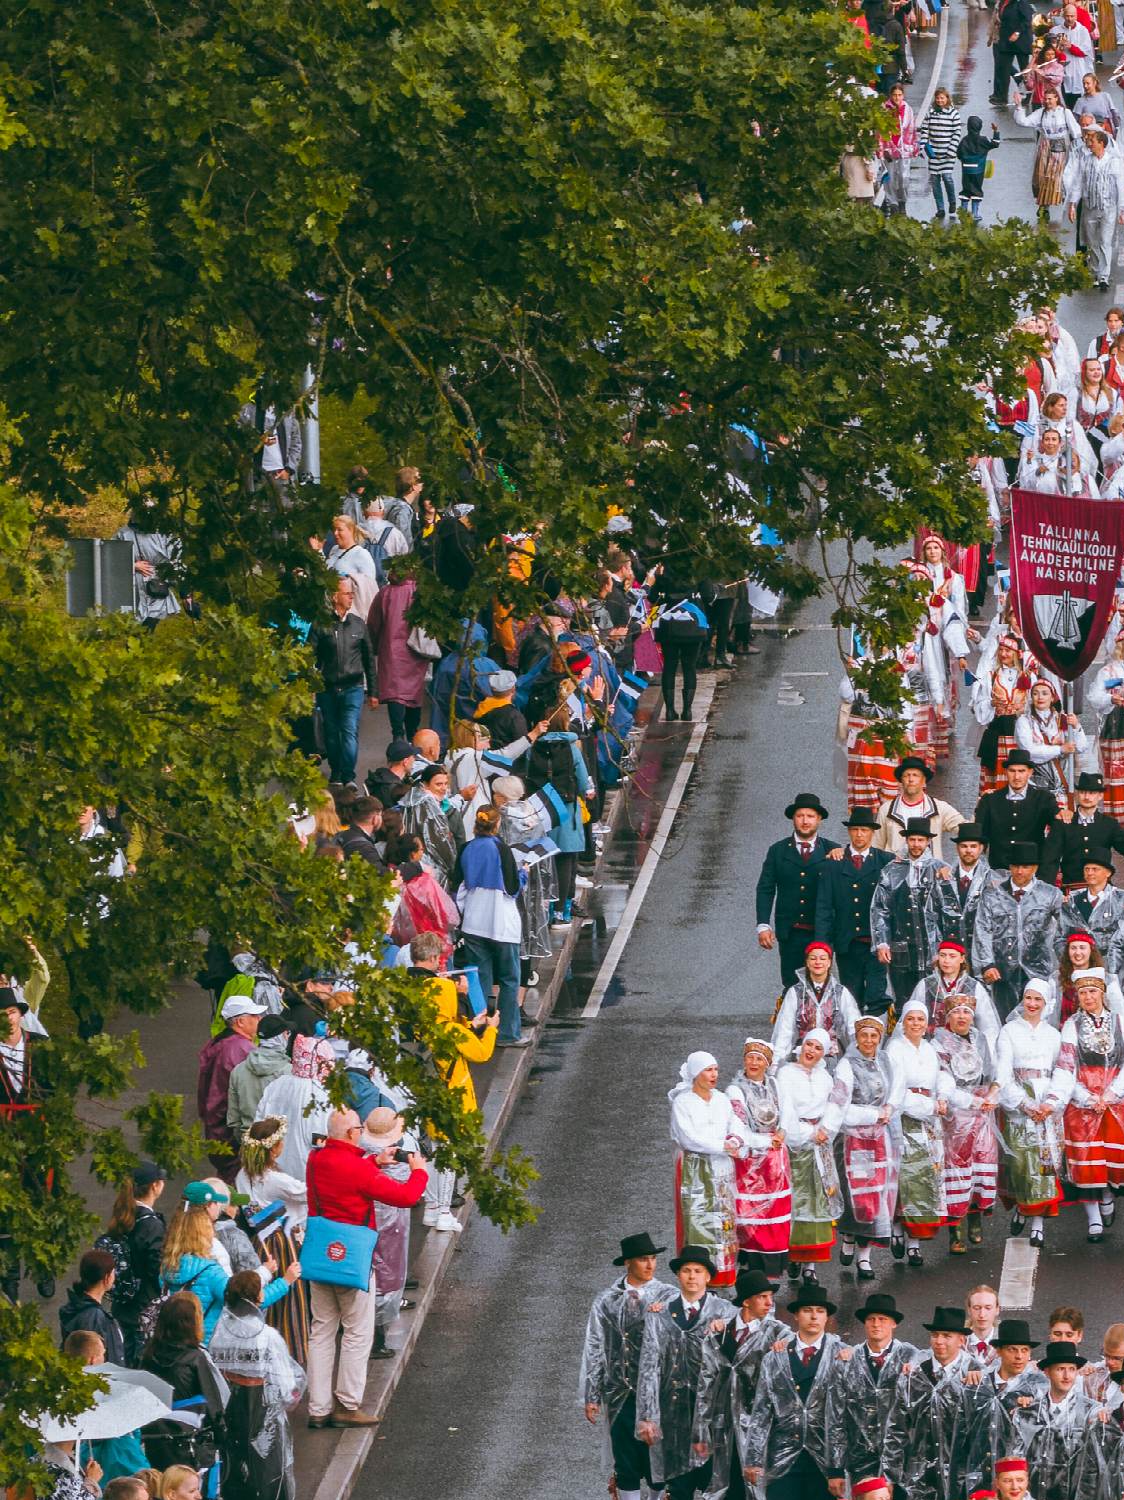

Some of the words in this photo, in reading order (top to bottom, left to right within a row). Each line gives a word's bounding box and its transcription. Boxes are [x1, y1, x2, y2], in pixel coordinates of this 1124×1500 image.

[1039, 522, 1100, 542] TALLINNA
[1021, 534, 1116, 557] TEHNIKAÜLIKOOLI
[1020, 549, 1114, 571] AKADEEMILINE
[1036, 566, 1098, 585] NAISKOOR
